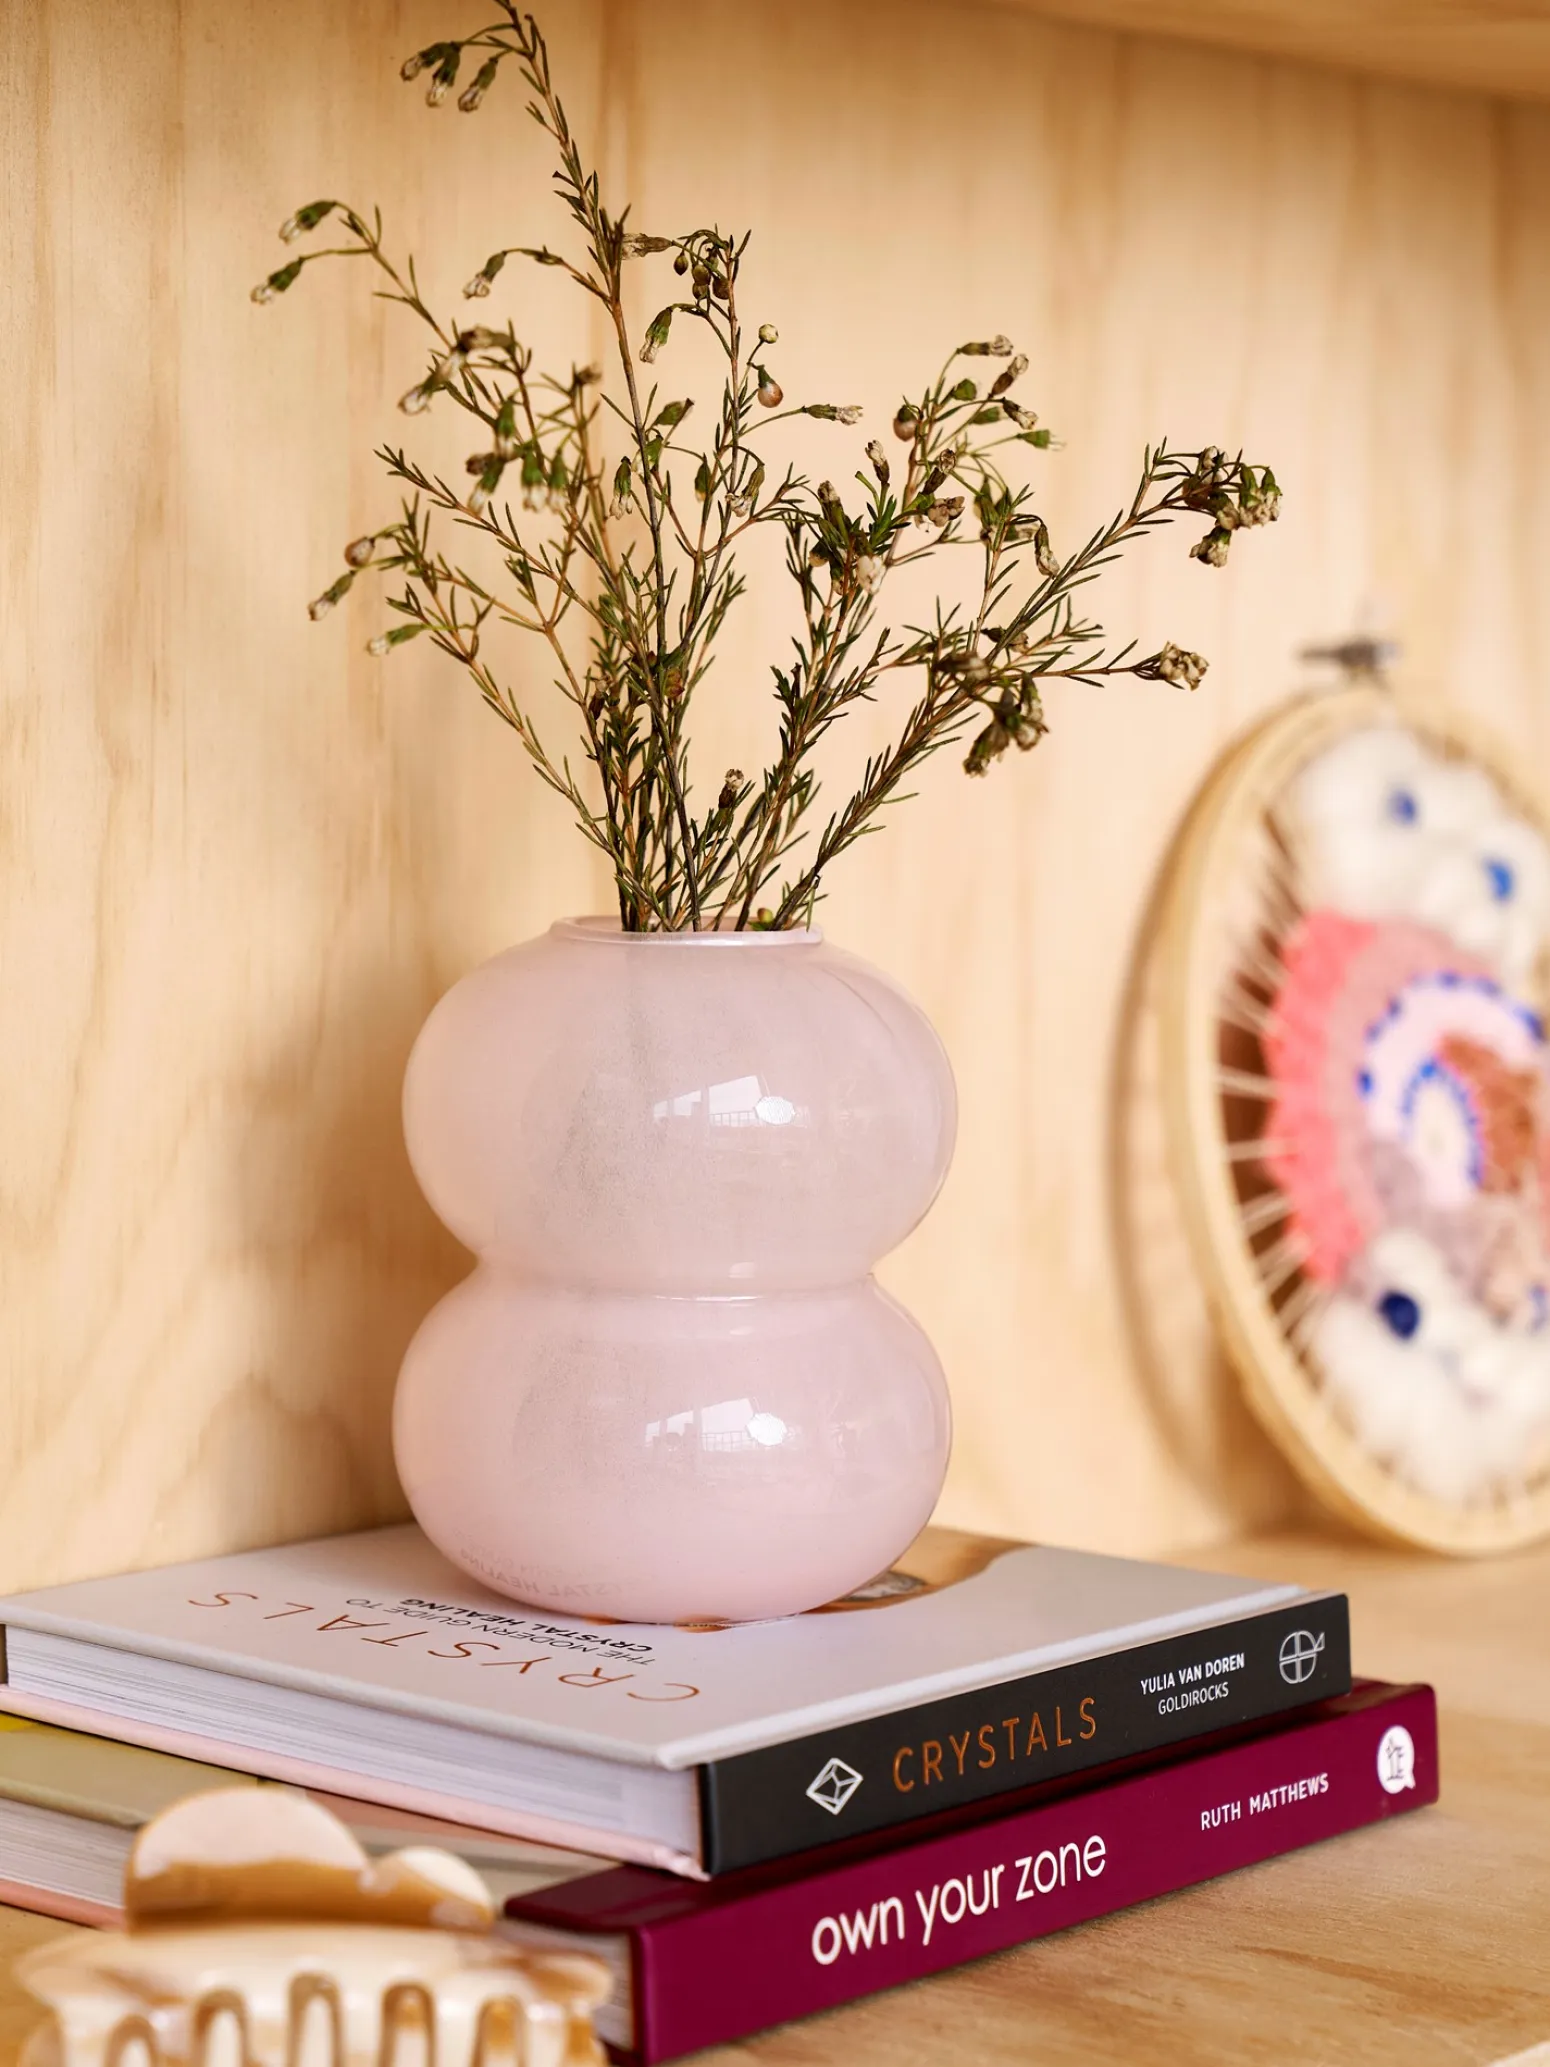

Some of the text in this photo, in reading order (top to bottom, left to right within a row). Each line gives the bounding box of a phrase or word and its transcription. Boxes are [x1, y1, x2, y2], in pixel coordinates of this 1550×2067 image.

[188, 1592, 699, 1701] CRYSTALS
[346, 1598, 656, 1666] THE MODERN GUIDE TO
[400, 1598, 653, 1653] CRYSTAL HEALING
[1140, 1652, 1245, 1695] YULIA VAN DOREN
[1157, 1681, 1230, 1716] GOLDIROCKS
[893, 1697, 1097, 1792] CRYSTALS
[1200, 1772, 1330, 1831] RUTH MATTHEWS
[811, 1834, 1107, 1966] own your zone
